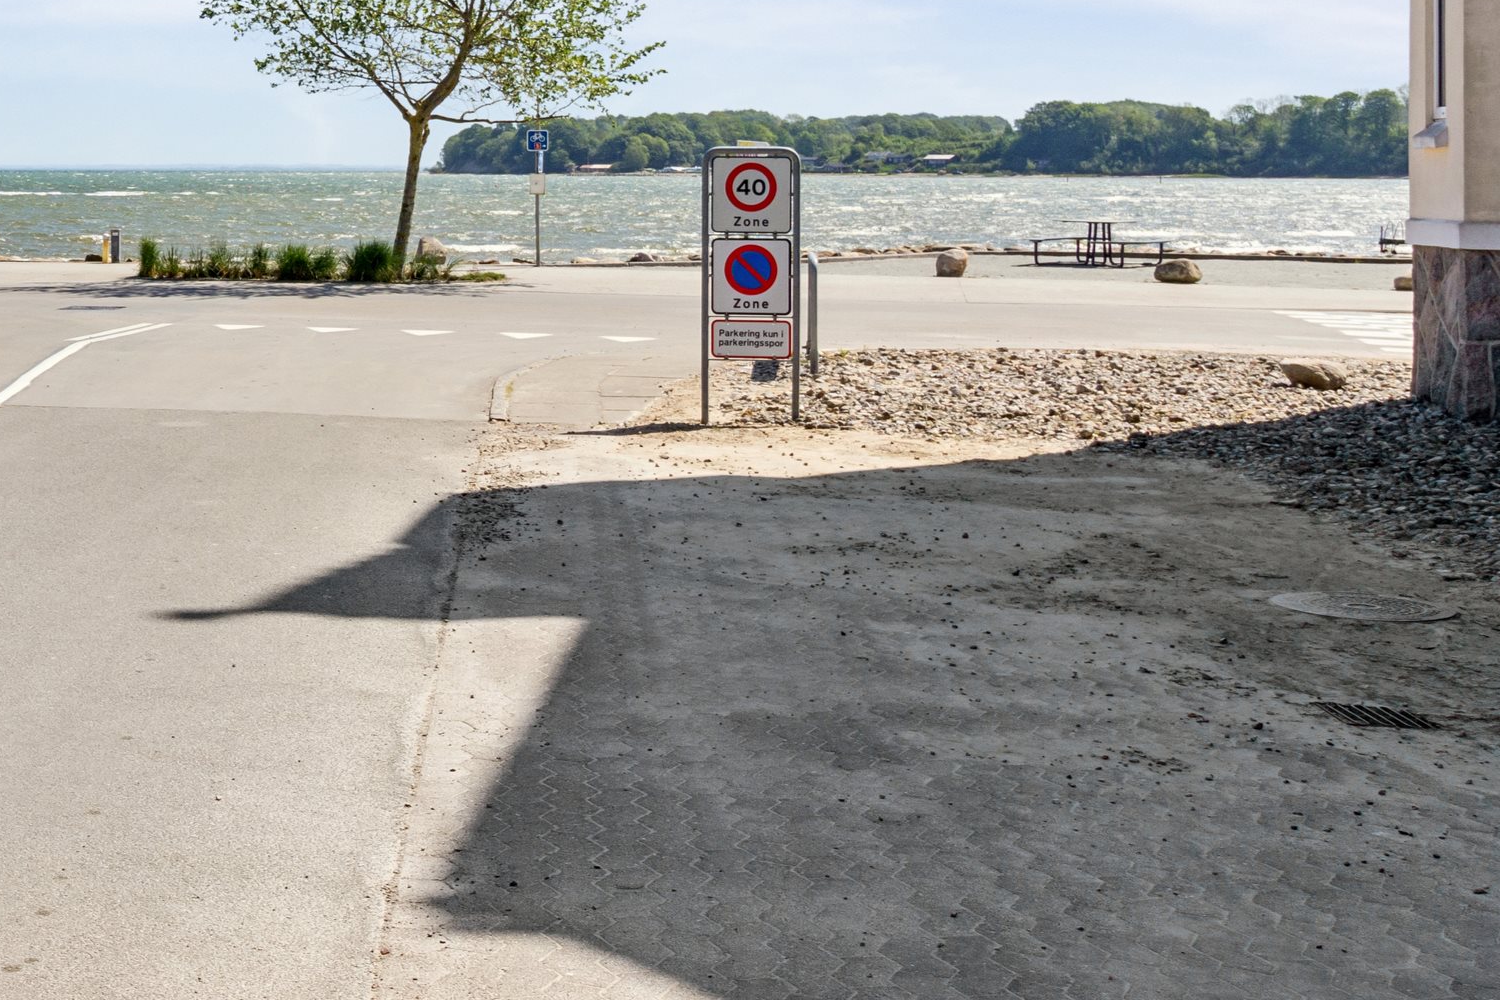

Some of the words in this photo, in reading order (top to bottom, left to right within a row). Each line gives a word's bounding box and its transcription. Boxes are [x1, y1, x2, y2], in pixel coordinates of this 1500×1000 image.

[736, 179, 766, 196] 40
[733, 216, 769, 227] Zone
[733, 298, 769, 309] Zone
[718, 329, 760, 339] Parkering
[763, 330, 779, 338] kun
[718, 339, 784, 348] parkeringsspor
